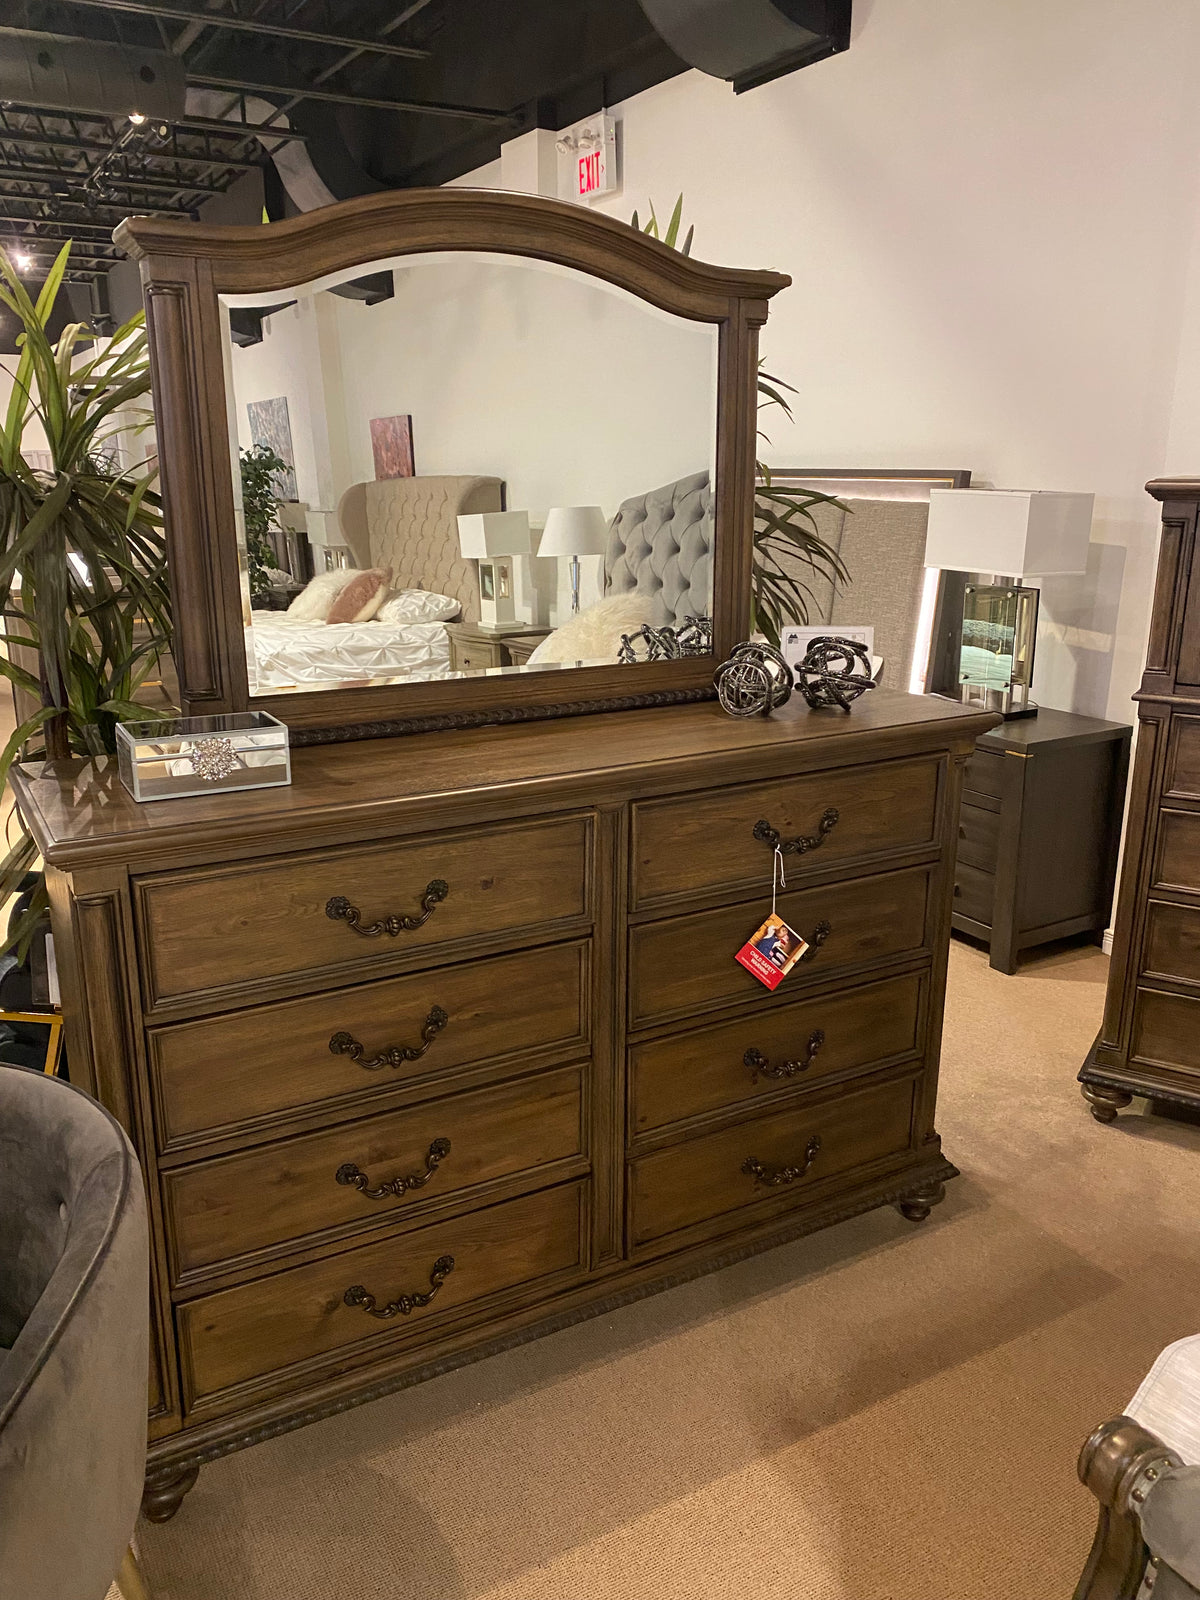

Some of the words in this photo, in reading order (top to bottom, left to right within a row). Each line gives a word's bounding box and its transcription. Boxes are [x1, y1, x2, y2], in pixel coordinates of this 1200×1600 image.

[579, 151, 600, 194] EXIT
[751, 958, 769, 975] WARNING
[760, 960, 776, 975] SAFETY
